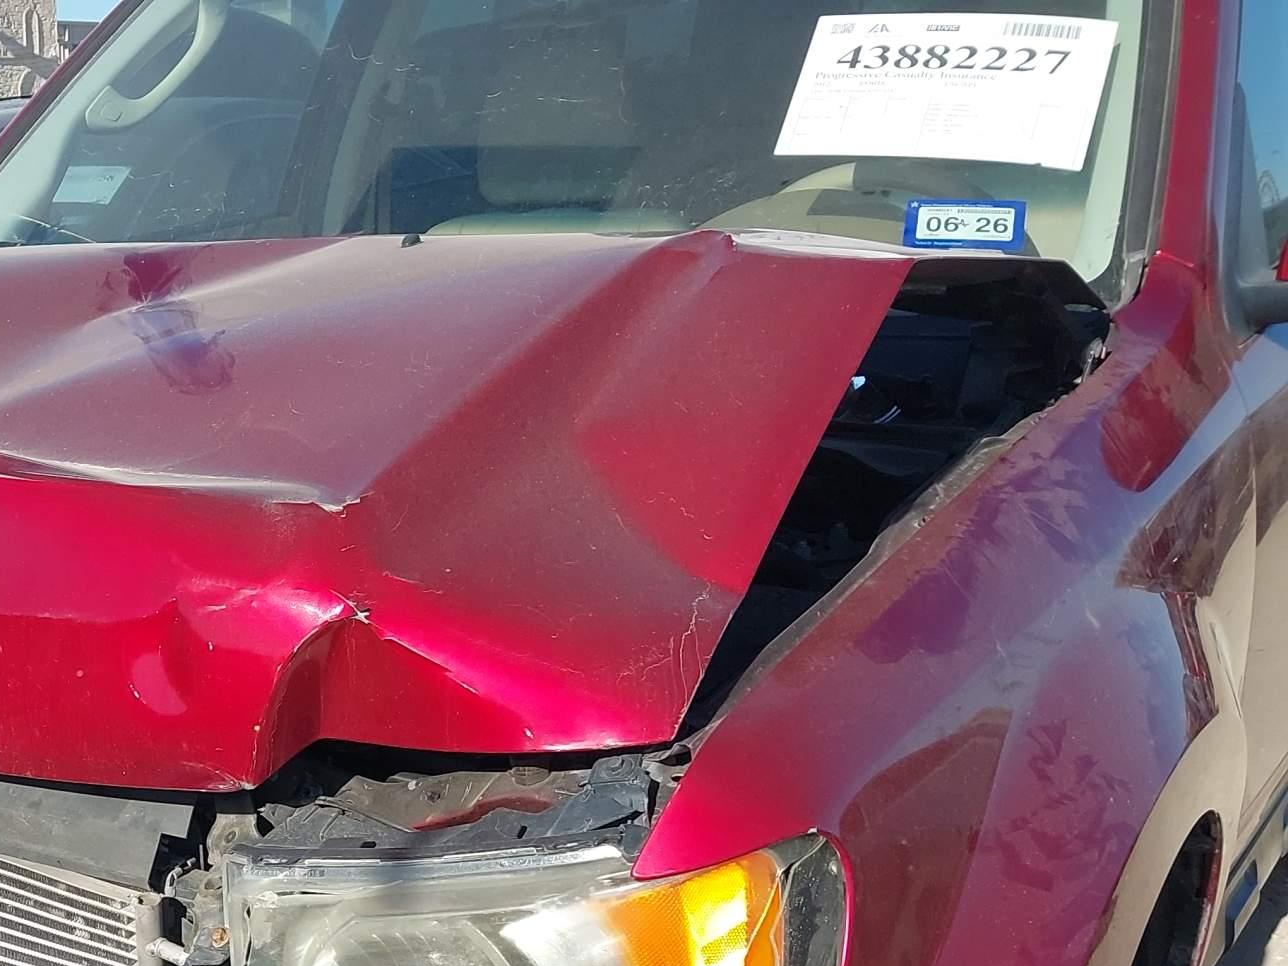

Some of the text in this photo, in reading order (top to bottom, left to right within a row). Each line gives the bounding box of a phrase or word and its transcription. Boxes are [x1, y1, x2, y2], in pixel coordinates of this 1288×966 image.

[837, 44, 1071, 75] 43882227
[926, 216, 1009, 233] 06 26
